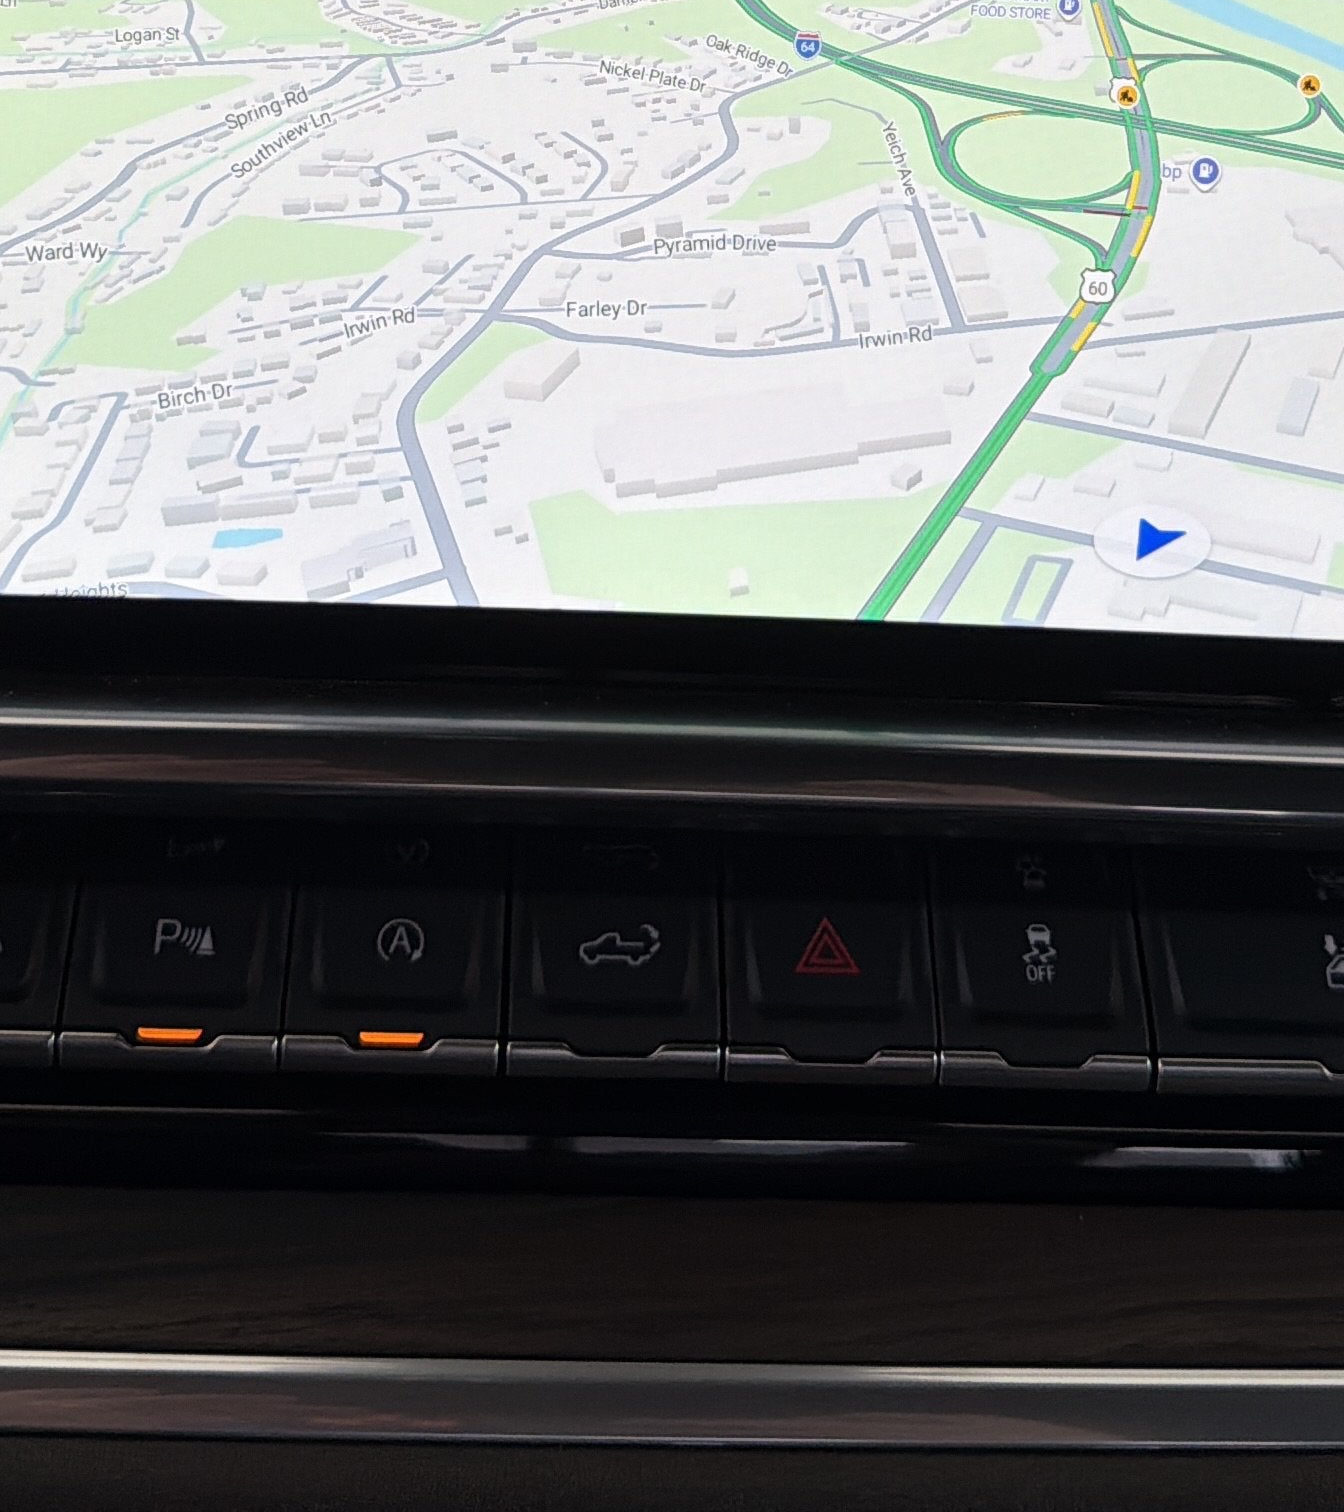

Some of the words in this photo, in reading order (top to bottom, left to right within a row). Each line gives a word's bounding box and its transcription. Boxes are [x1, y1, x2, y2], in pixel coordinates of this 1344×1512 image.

[970, 5, 1005, 18] FOOD
[1008, 6, 1052, 20] STORE
[114, 27, 163, 44] Logan
[165, 26, 180, 41] St
[705, 33, 735, 54] Oak
[735, 42, 776, 71] Ridge
[771, 60, 794, 79] Dr
[799, 40, 815, 54] 64
[599, 59, 646, 81] Nickel
[648, 68, 688, 90] Plate
[690, 76, 707, 93] Dr
[224, 98, 283, 131] Spring
[284, 86, 309, 109] Rd
[230, 123, 309, 179] Southview
[309, 110, 333, 131] Ln
[882, 121, 908, 165] Yeich
[897, 168, 916, 197] Ave
[1162, 163, 1183, 180] bp
[24, 242, 75, 263] Ward
[78, 241, 109, 263] Wy
[653, 233, 727, 256] Pyramid
[732, 234, 777, 251] Drive
[1087, 281, 1108, 296] 60
[565, 301, 622, 321] Farley
[626, 300, 648, 316] Dr
[343, 313, 388, 339] Irwin
[391, 306, 416, 325] Rd
[858, 327, 905, 349] Irwin
[908, 324, 934, 343] Rd
[157, 386, 207, 409] Birch
[210, 382, 233, 400] Dr
[1025, 964, 1056, 983] OFF
